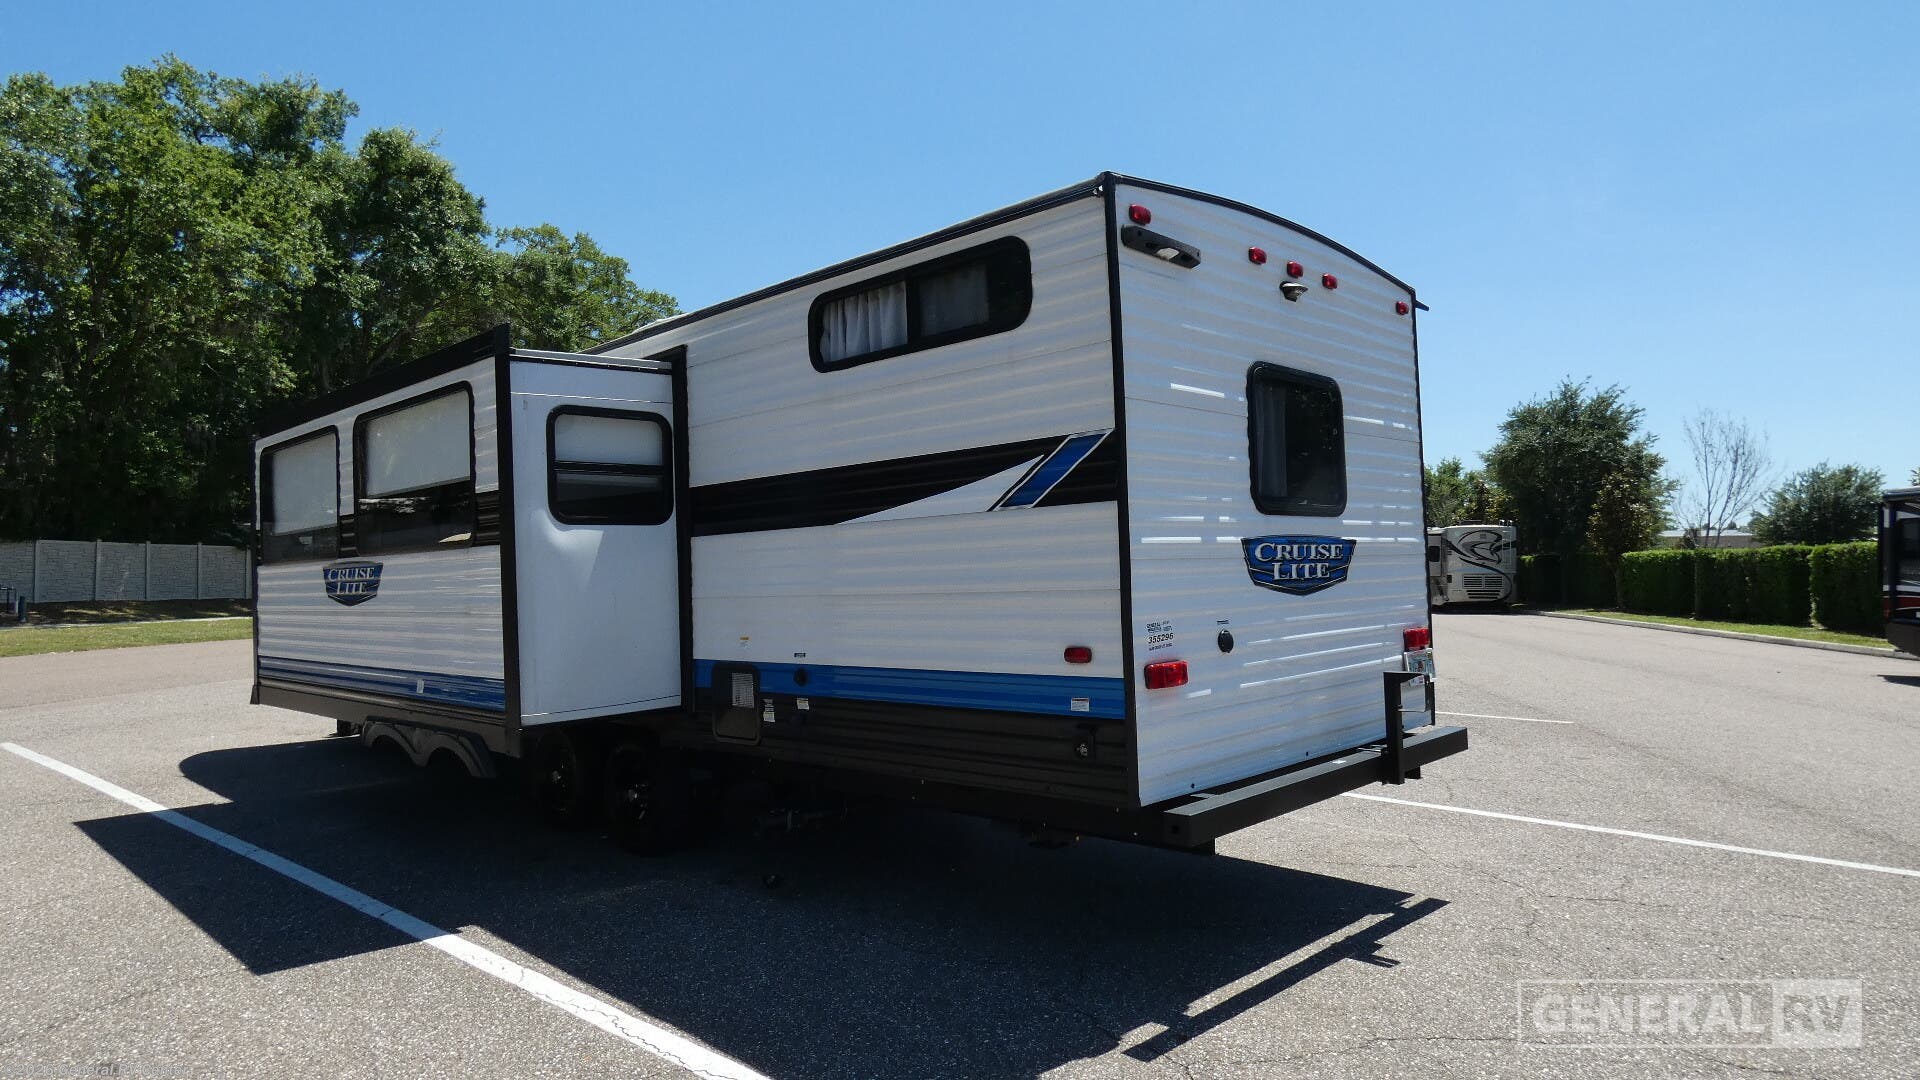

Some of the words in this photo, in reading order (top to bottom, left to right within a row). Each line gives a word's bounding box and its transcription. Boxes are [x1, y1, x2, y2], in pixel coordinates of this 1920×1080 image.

[1254, 542, 1344, 562] CRUISE
[328, 567, 375, 582] CRUISE
[1272, 562, 1331, 580] LITE
[336, 582, 368, 595] LITE
